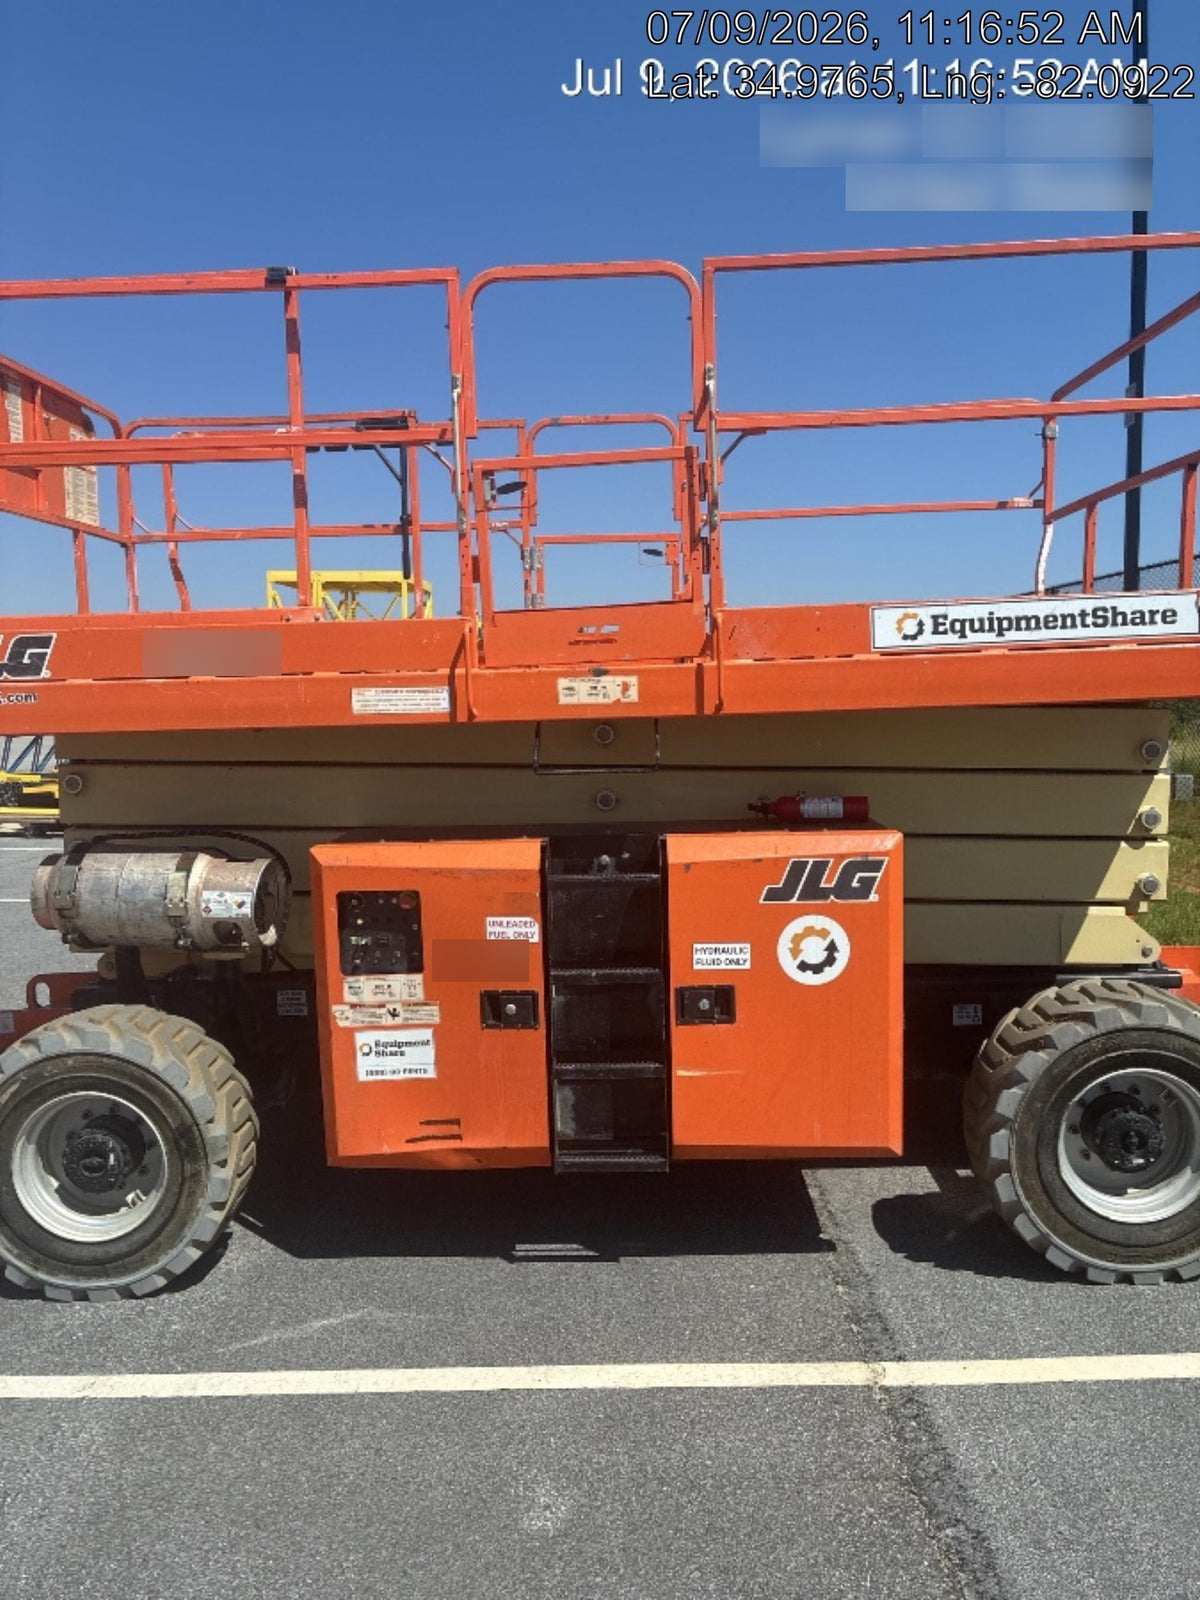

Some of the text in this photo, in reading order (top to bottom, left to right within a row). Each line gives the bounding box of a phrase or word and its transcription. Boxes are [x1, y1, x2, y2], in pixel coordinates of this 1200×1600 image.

[931, 606, 1178, 639] EquipmentShare
[759, 857, 889, 904] JLG
[488, 920, 536, 928] UNLEADED
[488, 931, 536, 939] FUEL ONLY
[695, 946, 749, 955] HYDRAULIC
[695, 957, 747, 966] FLUID ONLY
